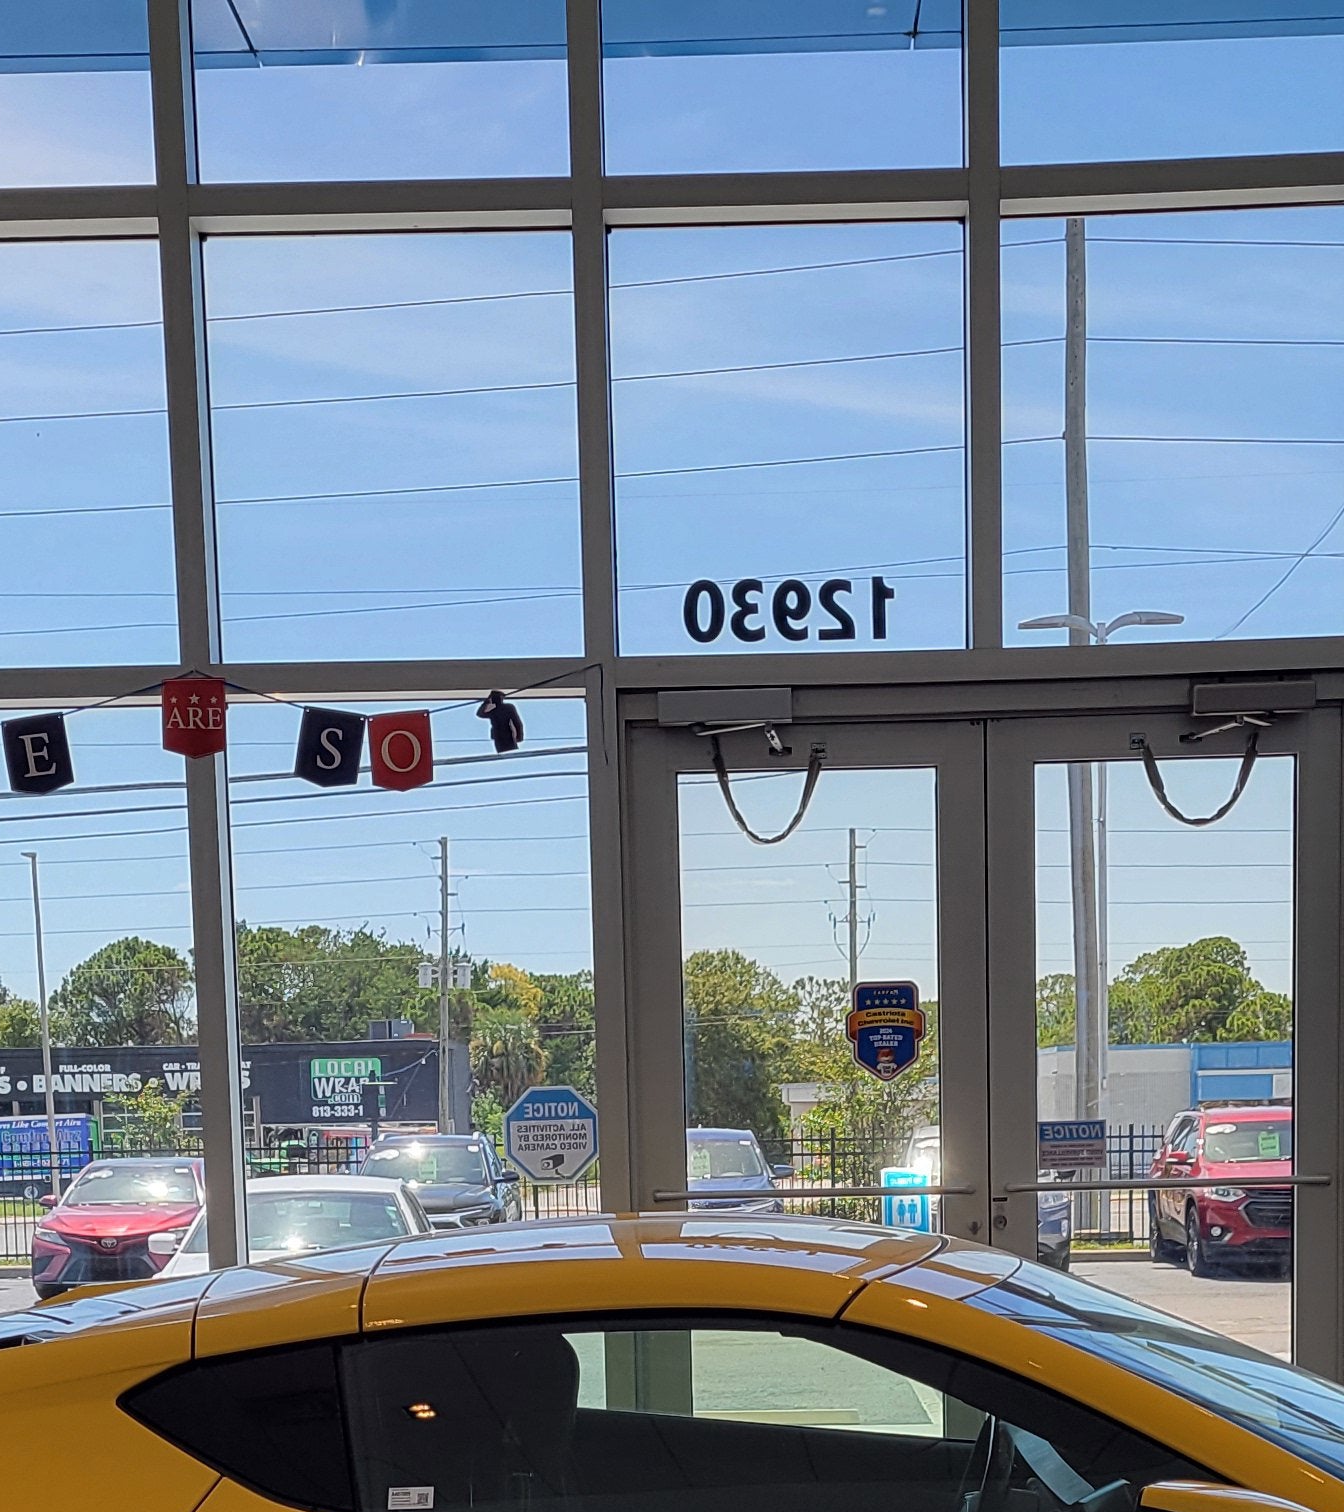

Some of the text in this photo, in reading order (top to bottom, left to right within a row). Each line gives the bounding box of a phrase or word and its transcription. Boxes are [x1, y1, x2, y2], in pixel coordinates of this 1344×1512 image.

[166, 705, 223, 731] ARE
[316, 727, 422, 774] SO
[59, 1064, 111, 1073] FULL-COLOR
[162, 1062, 180, 1071] CAR
[328, 1093, 361, 1104] .com
[12, 1121, 30, 1129] Like
